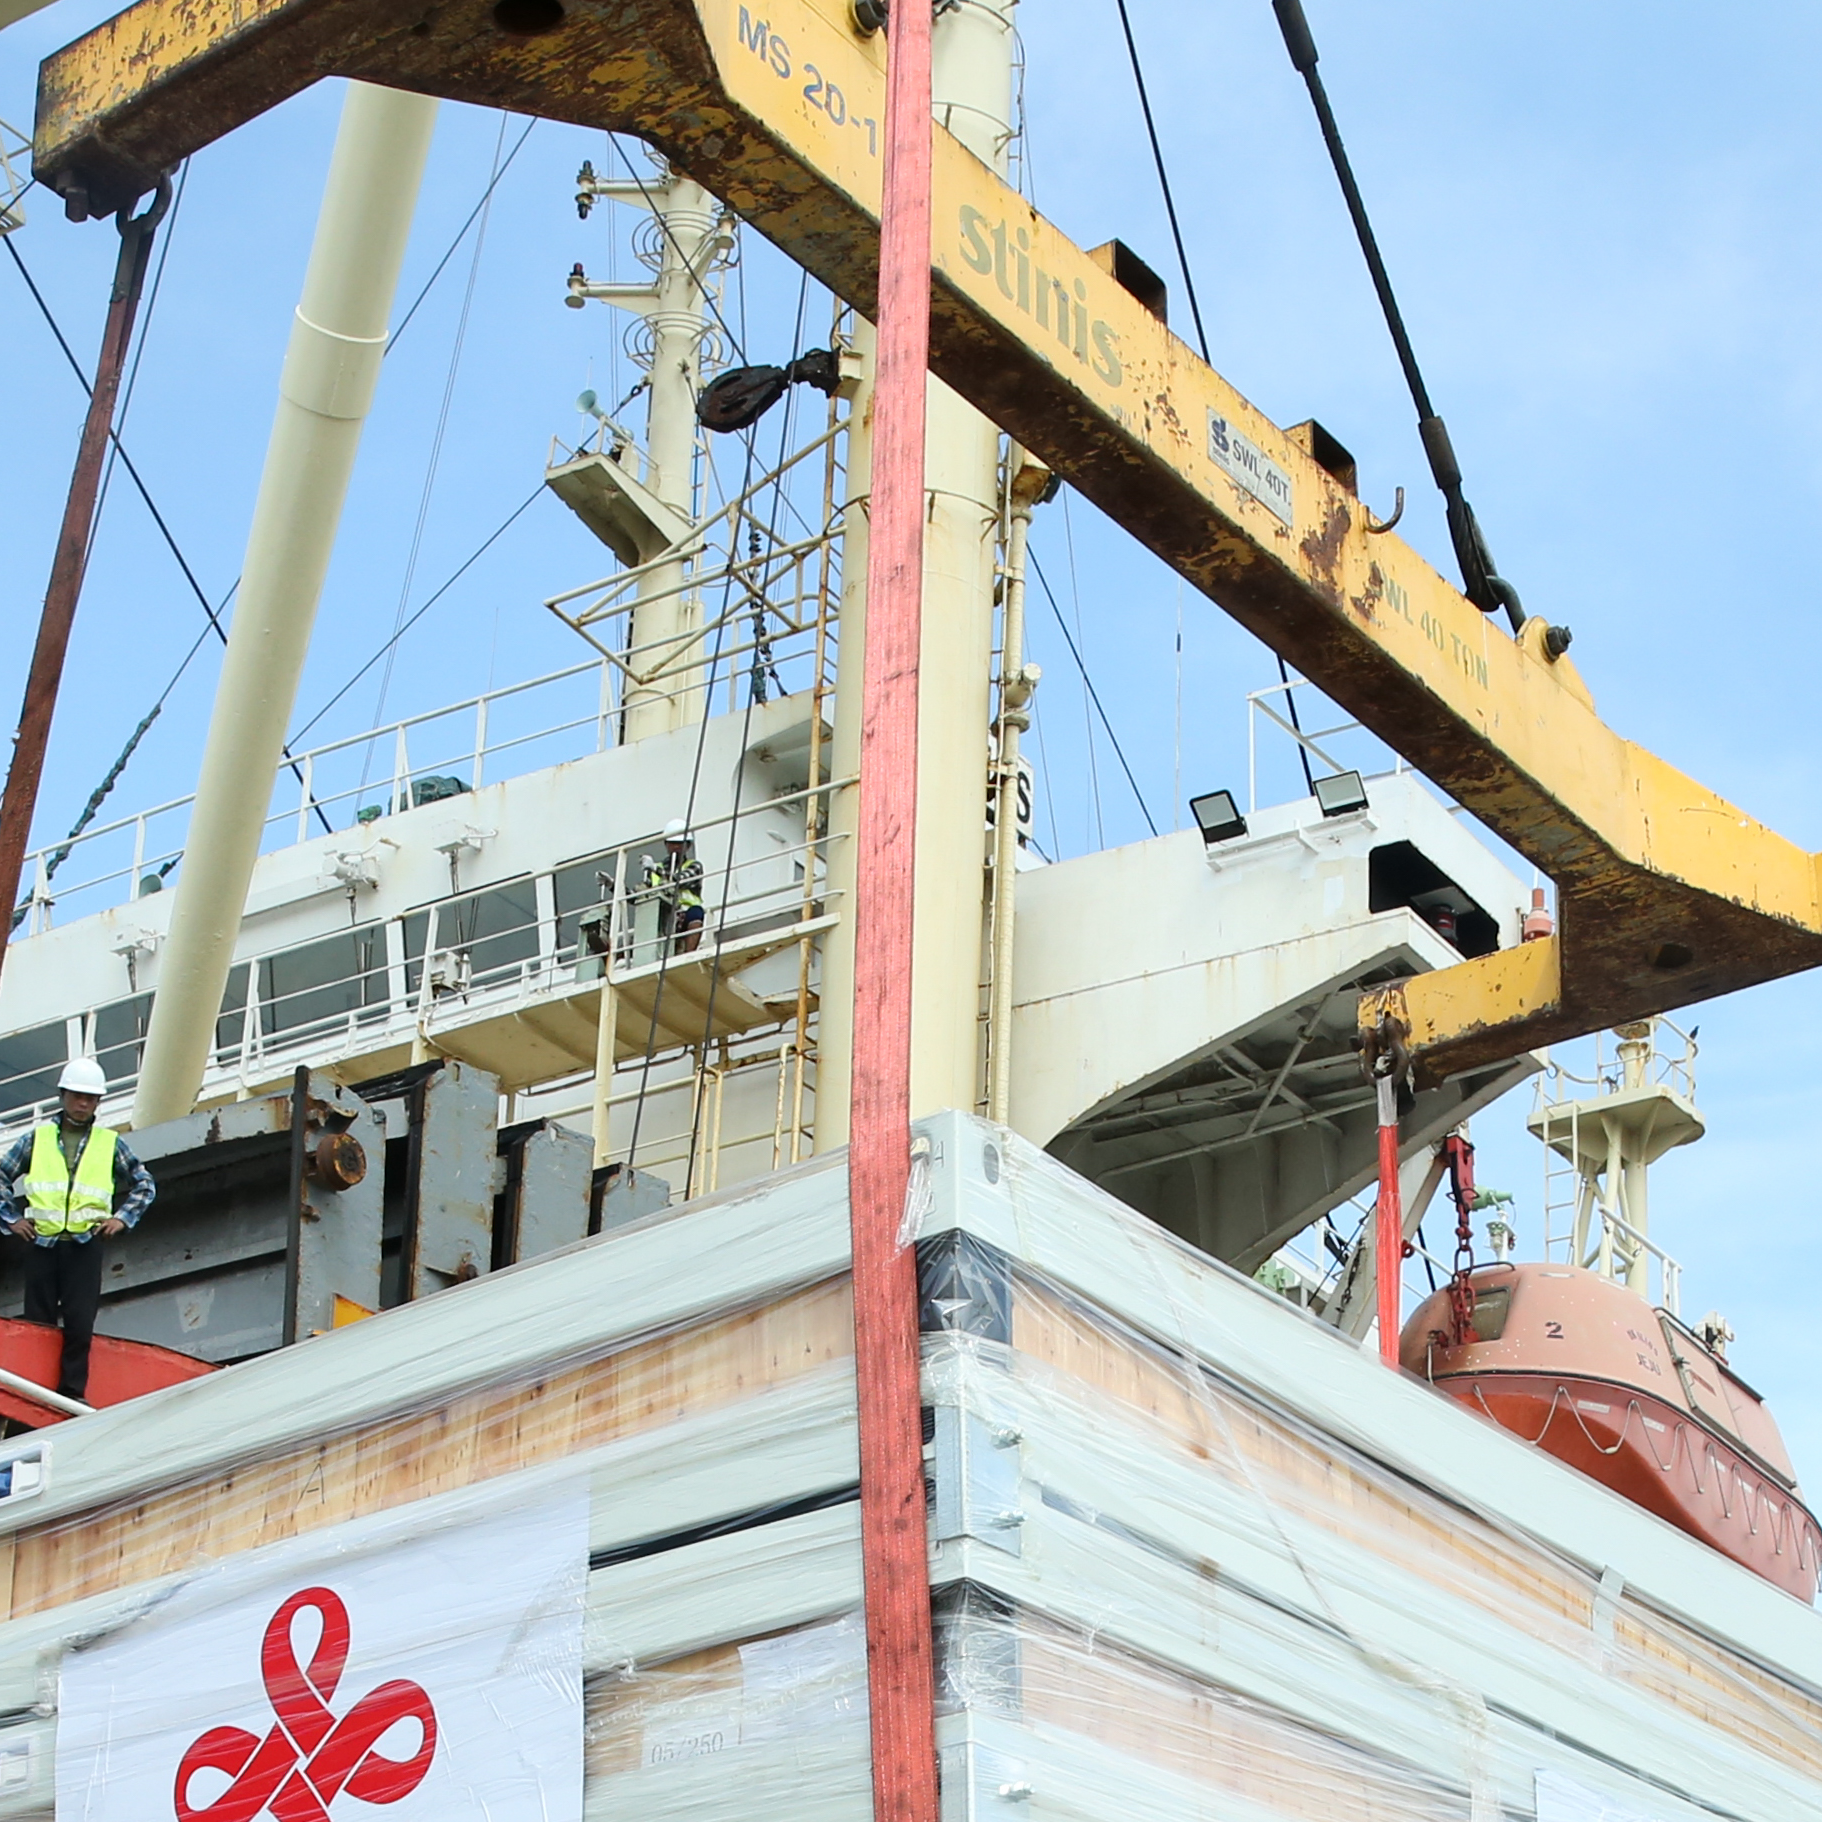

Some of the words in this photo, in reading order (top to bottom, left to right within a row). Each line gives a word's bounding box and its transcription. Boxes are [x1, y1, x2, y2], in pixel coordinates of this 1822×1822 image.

[738, 4, 792, 79] MS
[803, 63, 876, 157] 20-1
[959, 204, 1123, 388] stinis
[1232, 439, 1261, 480] SWL
[1265, 469, 1289, 503] 40T
[1420, 611, 1444, 651] 40
[1450, 632, 1488, 691] TON
[1545, 1321, 1565, 1340] 2
[1636, 1352, 1662, 1376] JEJU
